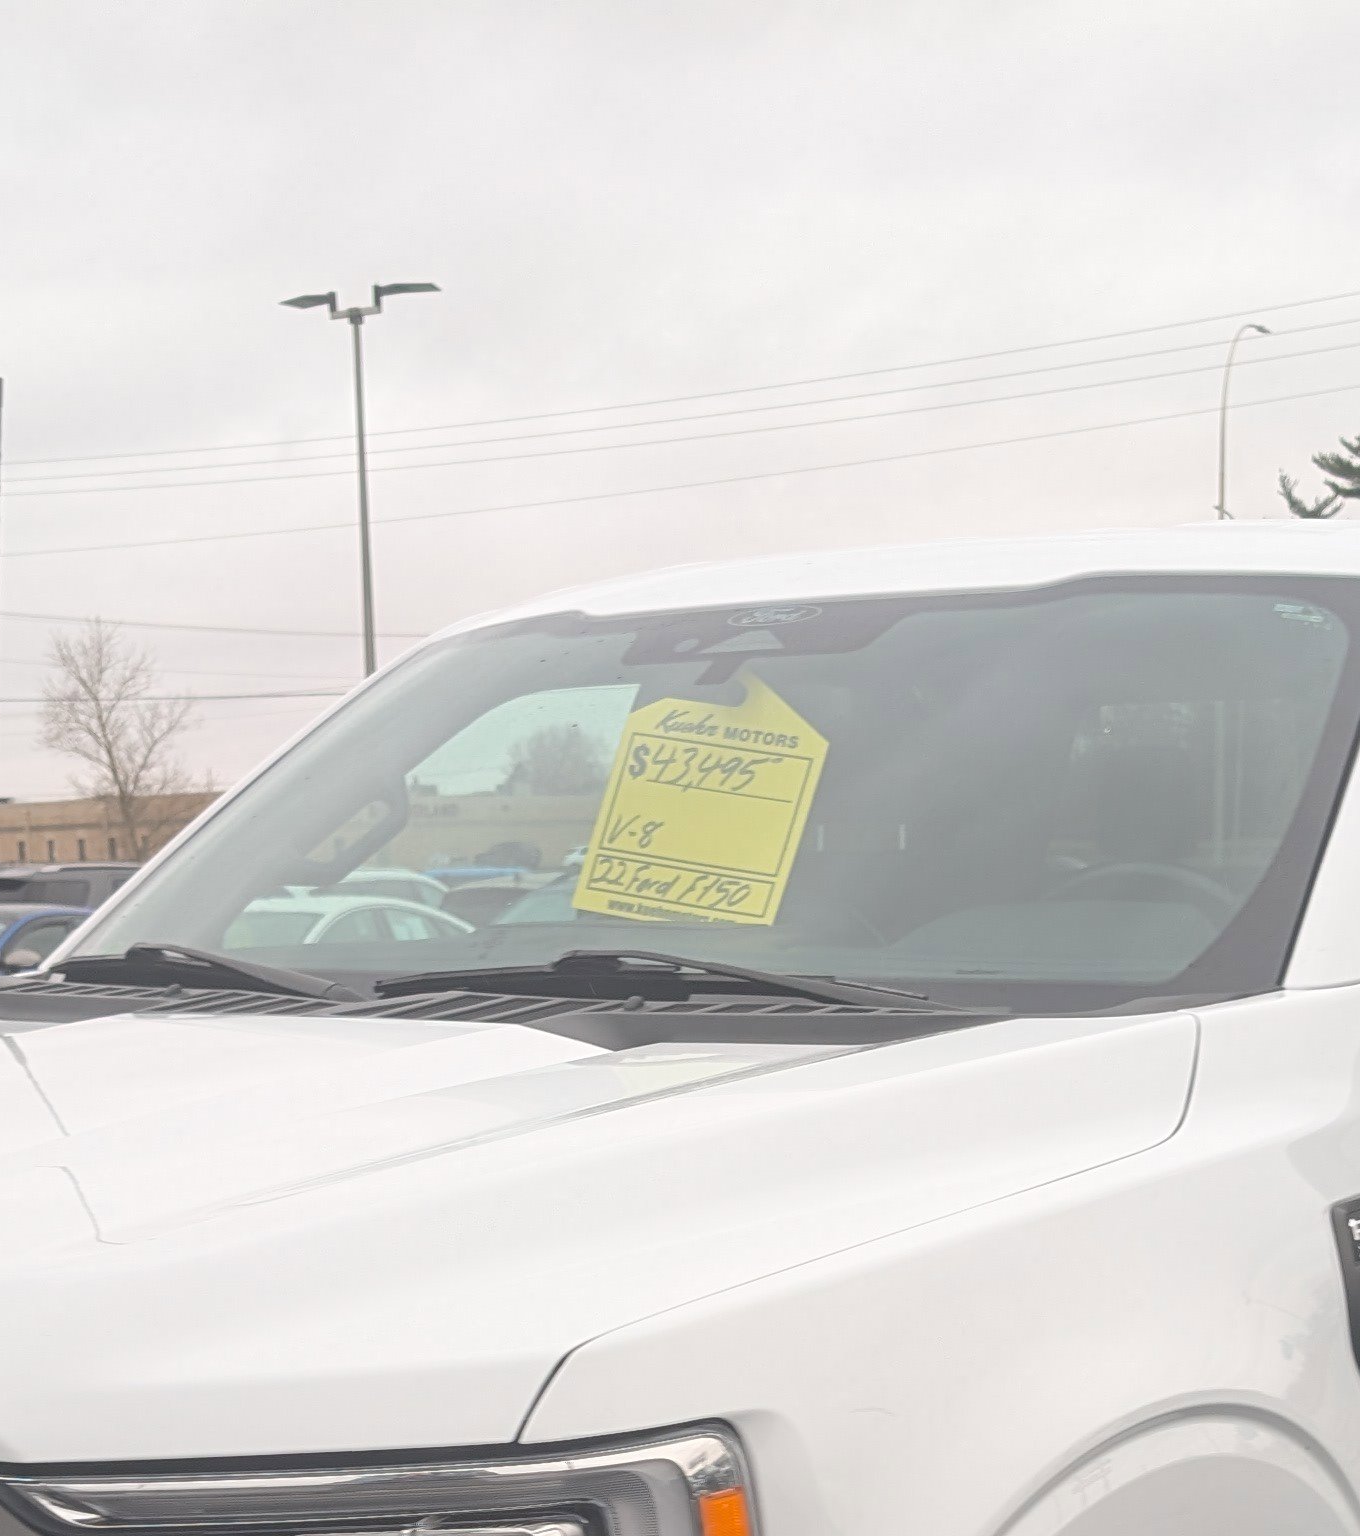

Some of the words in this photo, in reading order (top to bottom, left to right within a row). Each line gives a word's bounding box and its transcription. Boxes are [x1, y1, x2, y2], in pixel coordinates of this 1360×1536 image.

[723, 726, 800, 750] MOTORS
[607, 815, 664, 849] V-8
[625, 864, 682, 897] Ford
